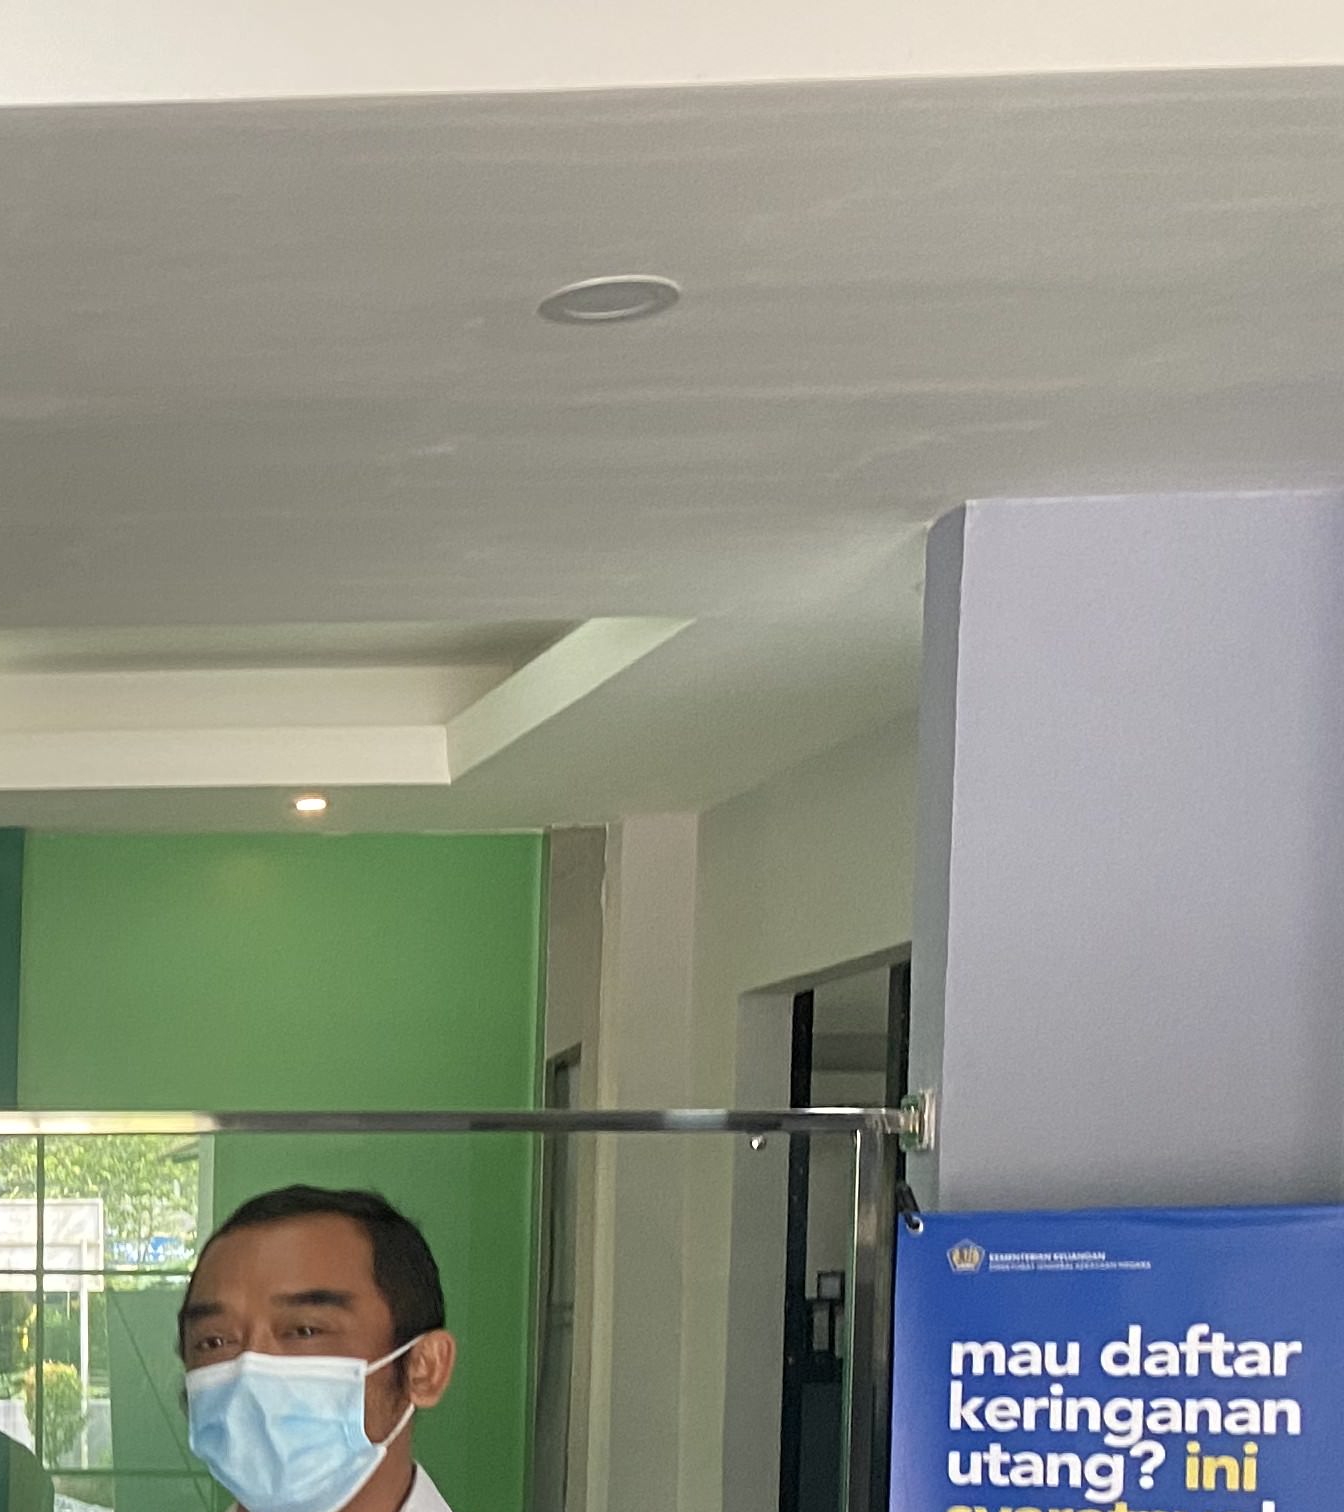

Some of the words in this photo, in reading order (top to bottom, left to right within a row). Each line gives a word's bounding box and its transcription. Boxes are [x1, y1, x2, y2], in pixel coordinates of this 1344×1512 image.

[950, 1340, 1080, 1377] mau
[1100, 1323, 1302, 1377] daftar
[948, 1380, 1302, 1448] keringanan
[947, 1440, 1166, 1504] utang?
[1185, 1441, 1259, 1492] ini
